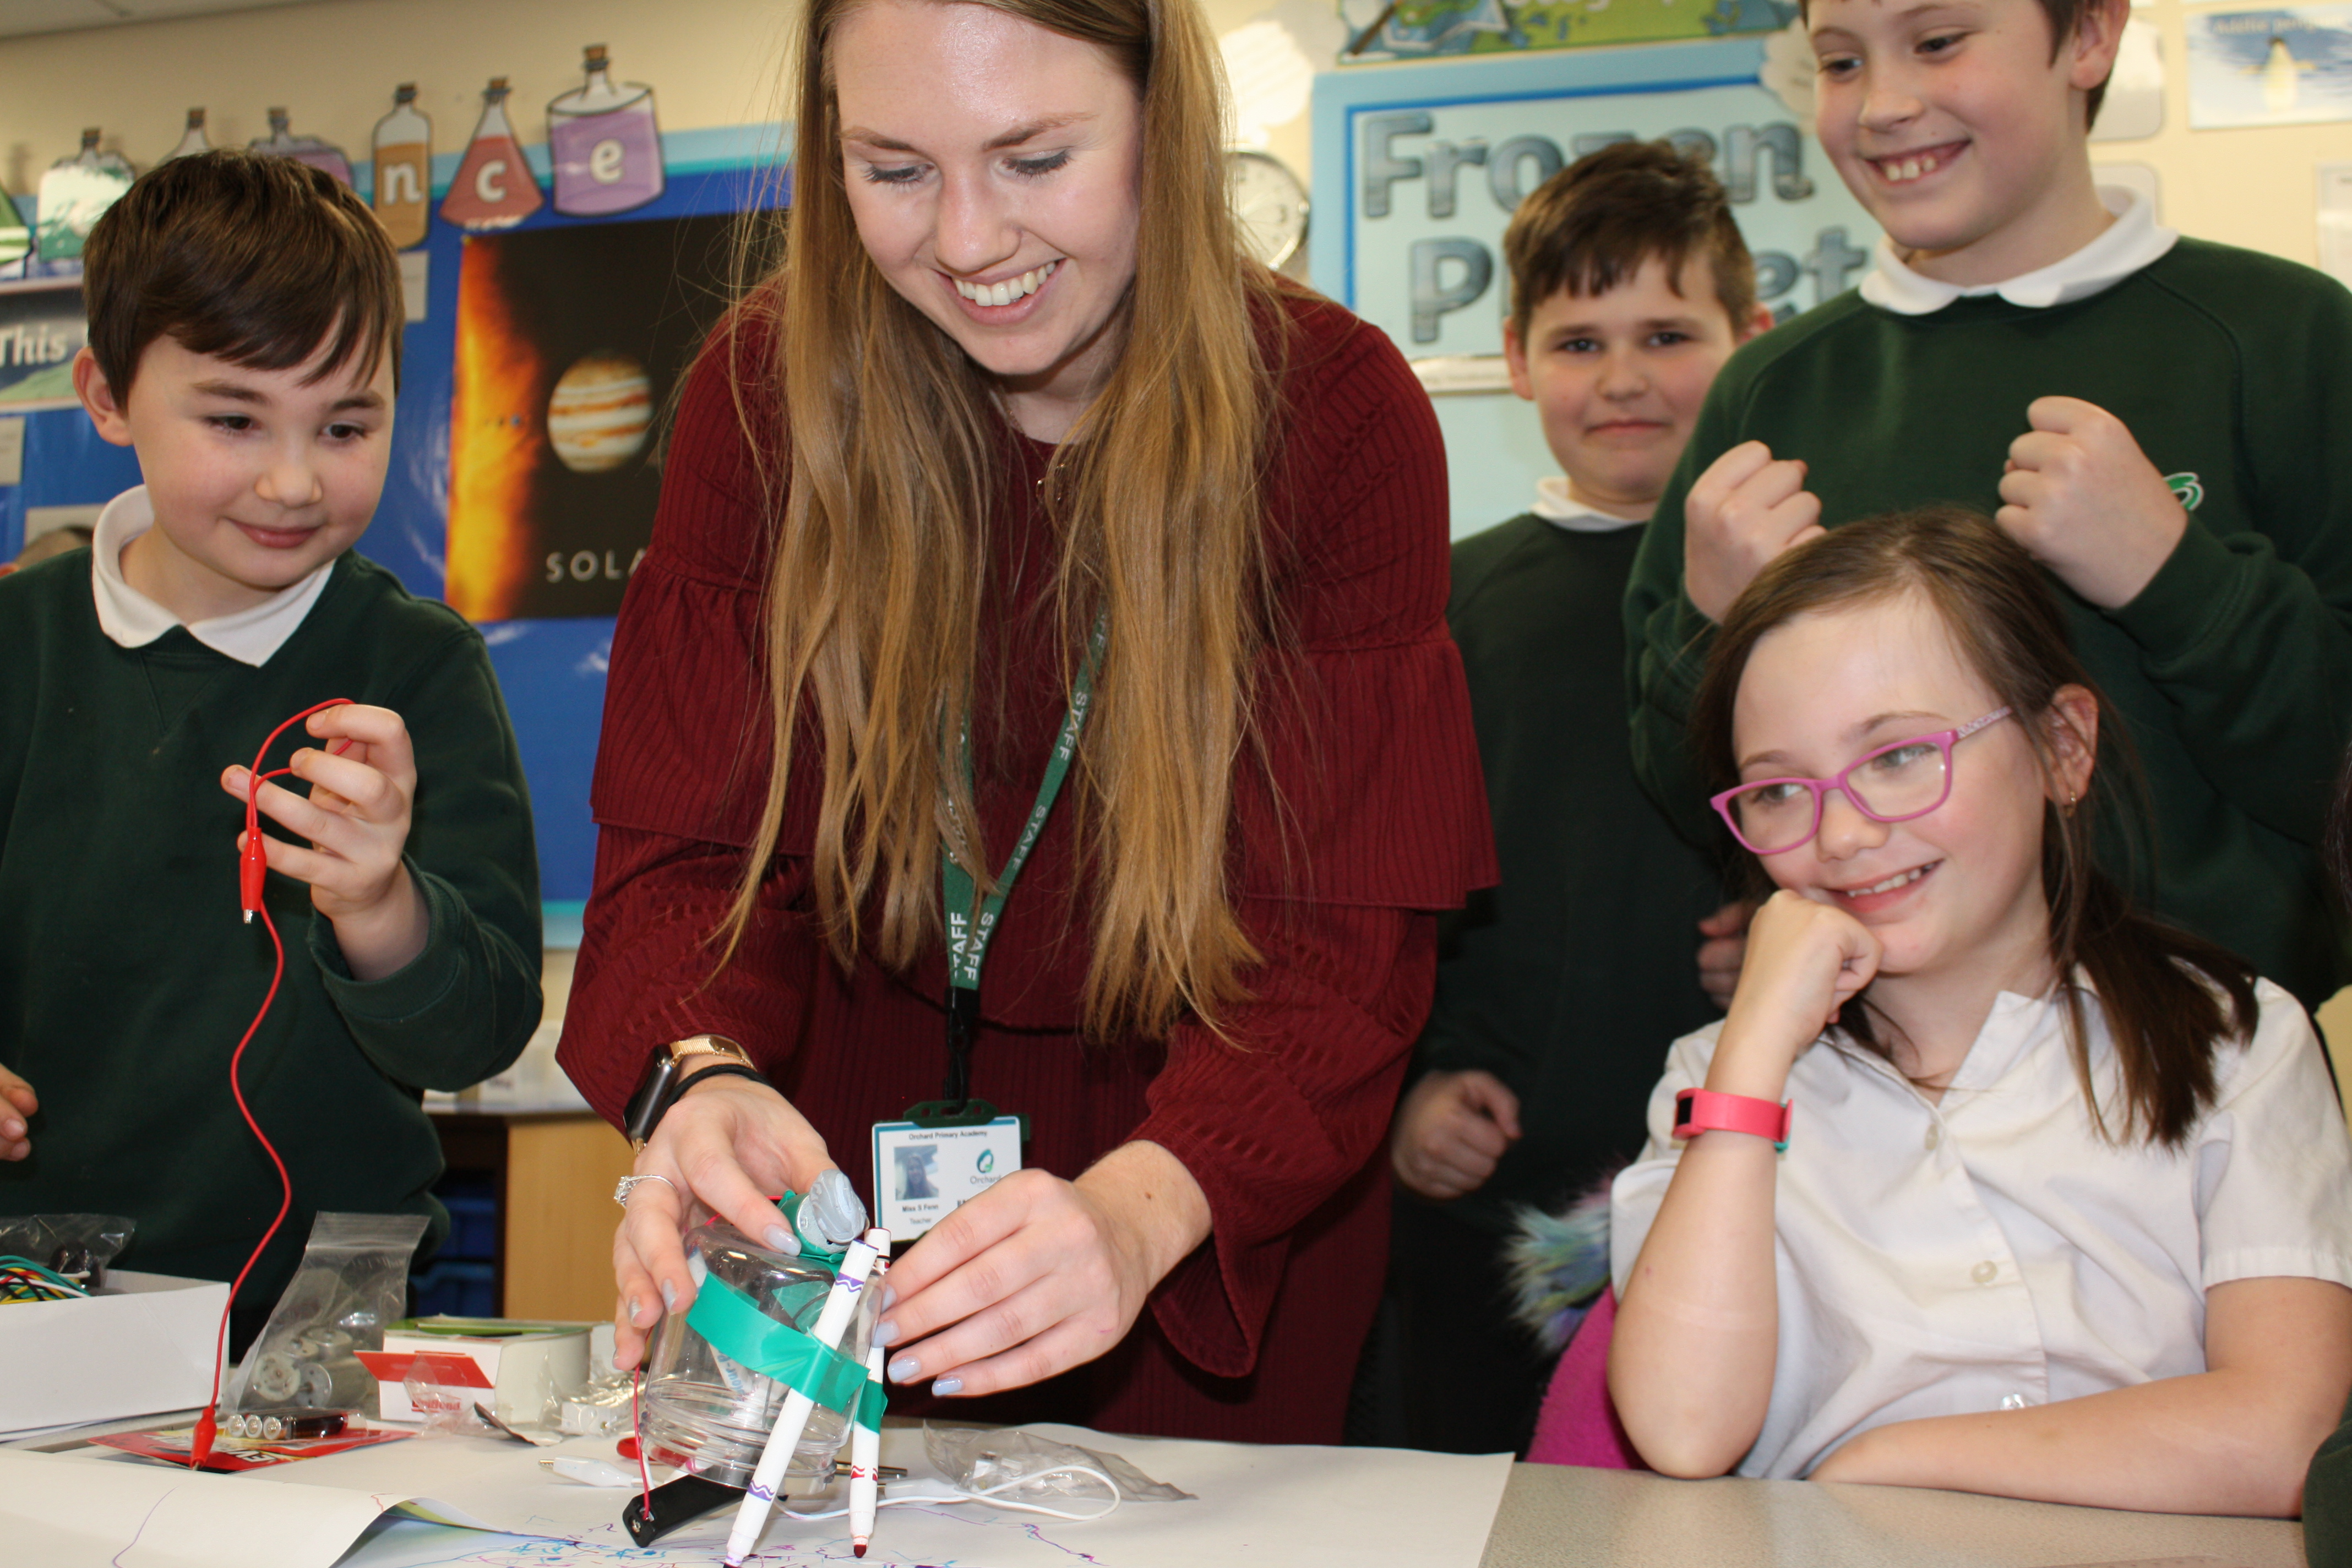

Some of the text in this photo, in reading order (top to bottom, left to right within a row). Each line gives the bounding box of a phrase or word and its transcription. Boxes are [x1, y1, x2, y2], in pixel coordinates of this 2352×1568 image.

[0, 324, 68, 367] This
[1059, 692, 1088, 761] STAFF
[1012, 804, 1046, 870] STAFF
[950, 912, 967, 979] TAFF
[964, 912, 994, 981] STAFF
[970, 1175, 1001, 1184] Orchard
[910, 1217, 932, 1225] Teacher
